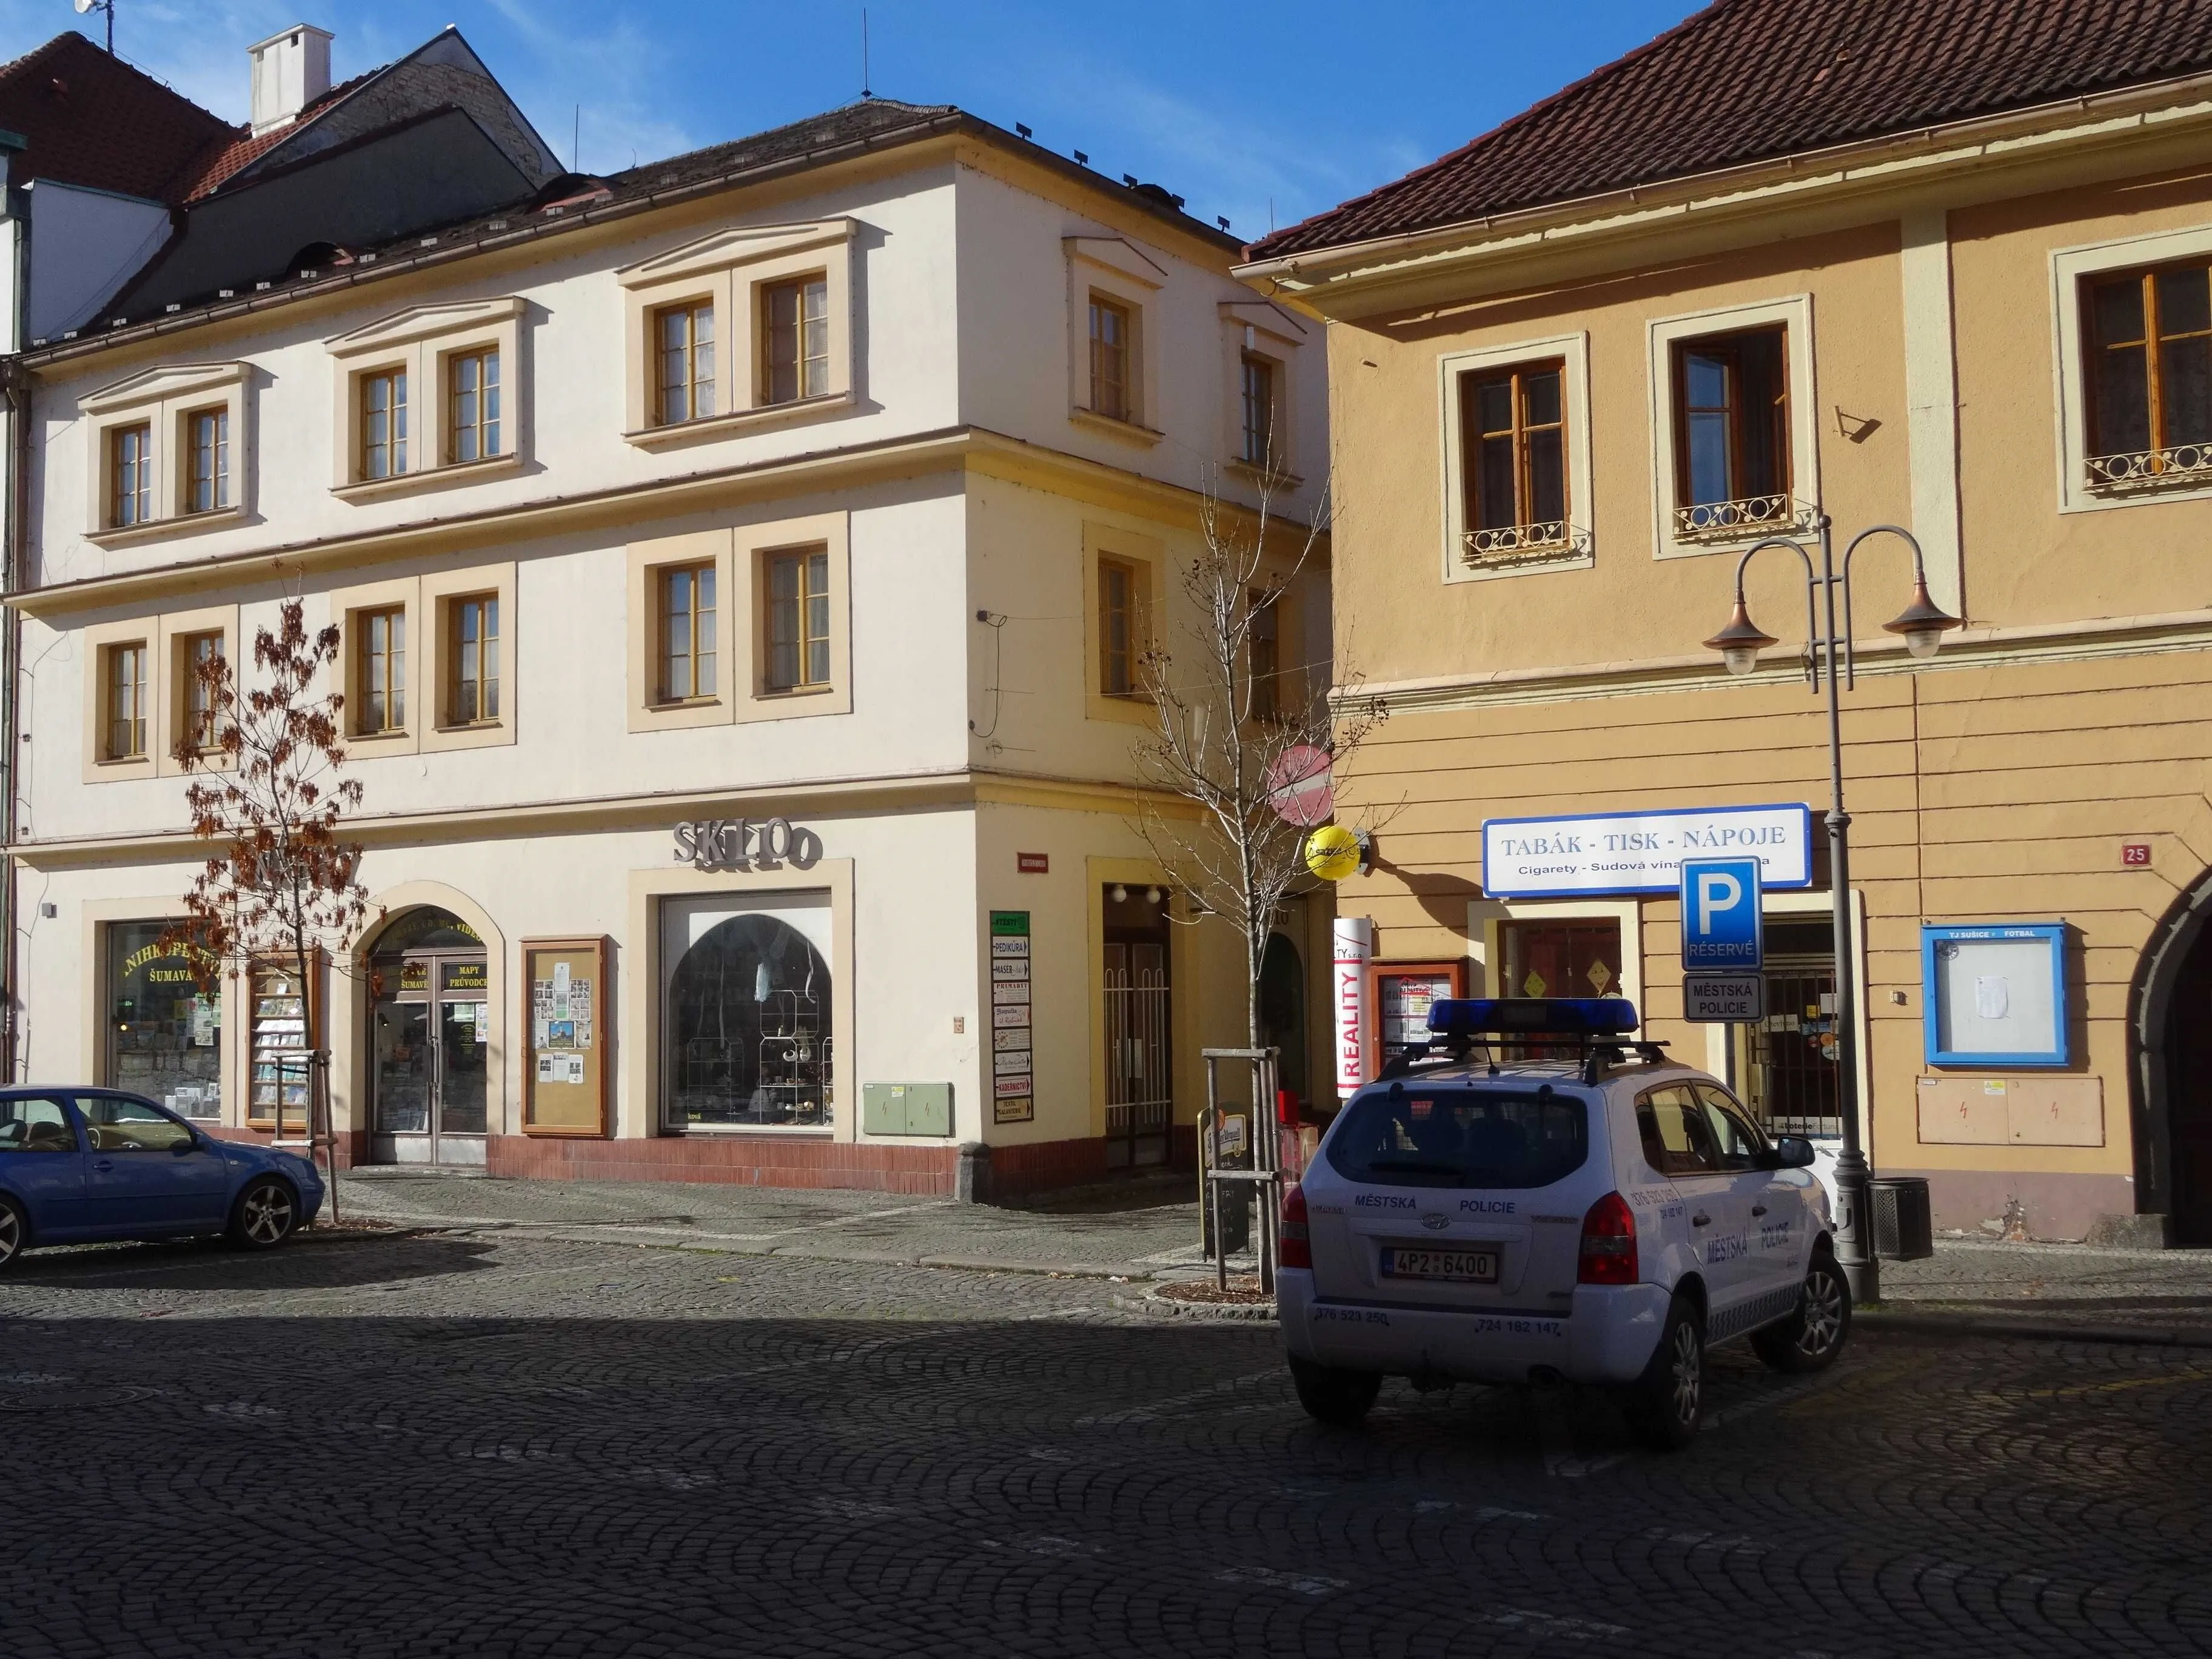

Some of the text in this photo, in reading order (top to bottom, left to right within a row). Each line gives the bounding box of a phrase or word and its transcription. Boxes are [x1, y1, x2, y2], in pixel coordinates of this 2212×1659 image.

[674, 817, 793, 862] SKLO
[1501, 833, 1582, 856] TABÁK
[1604, 831, 1660, 851] TISK
[1683, 825, 1786, 848] NÁPOJE
[2127, 849, 2145, 862] 25
[1518, 863, 1577, 877] Cigarety
[1591, 859, 1646, 872] Sudová
[1698, 873, 1741, 934] P
[1689, 940, 1754, 956] RÉSERVÉ
[150, 968, 194, 982] ŠUMAVA
[459, 966, 480, 974] MAPY
[1694, 982, 1752, 997] MĚSTSKÁ
[1700, 1002, 1748, 1014] POLICIE
[1341, 971, 1360, 1077] REALITY
[1355, 1193, 1417, 1209] MĚSTSKÁ
[1460, 1200, 1515, 1213] POLICIE
[1708, 1226, 1748, 1265] MĚSTSKÁ
[1398, 1253, 1487, 1275] 4P2 6400
[1478, 1319, 1501, 1331] 724
